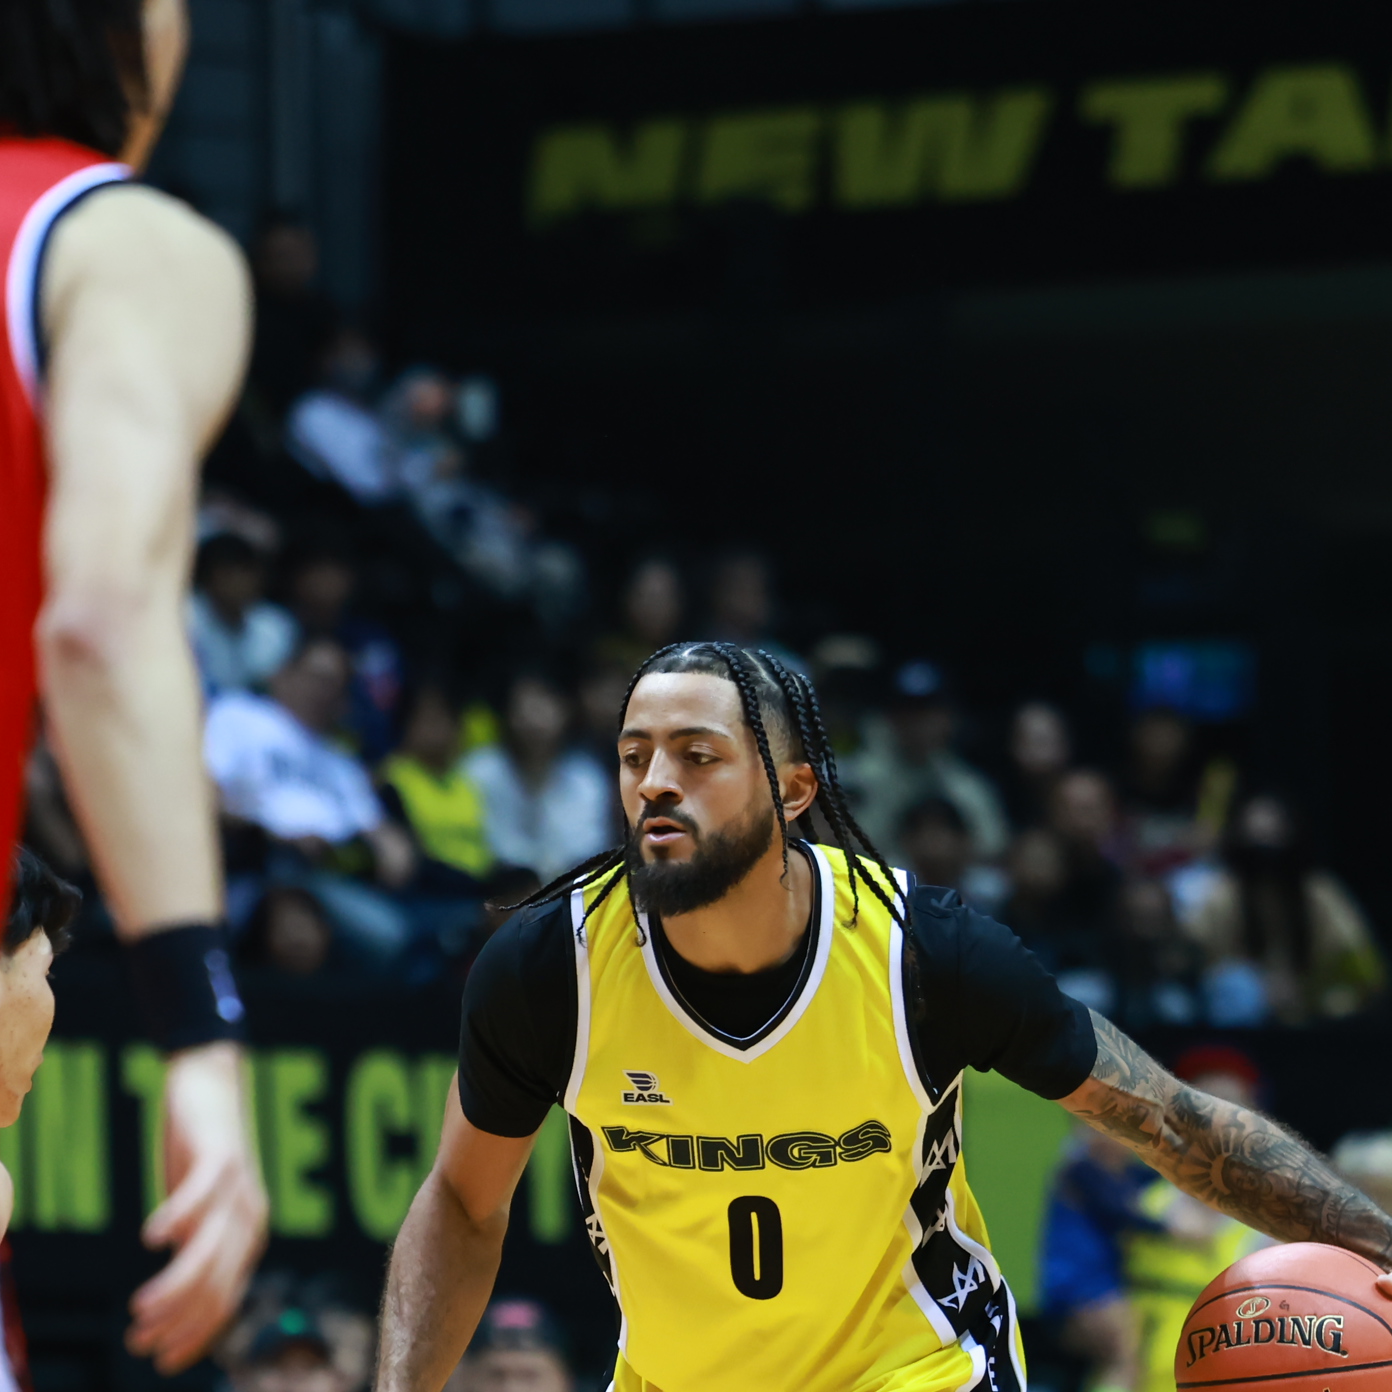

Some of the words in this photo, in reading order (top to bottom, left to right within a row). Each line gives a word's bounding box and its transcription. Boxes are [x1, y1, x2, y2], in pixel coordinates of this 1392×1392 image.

[528, 86, 1049, 226] NEW
[622, 1092, 670, 1104] EASL
[600, 1118, 892, 1172] KINGS
[727, 1195, 783, 1300] 0
[1186, 1315, 1345, 1368] SPALDING
